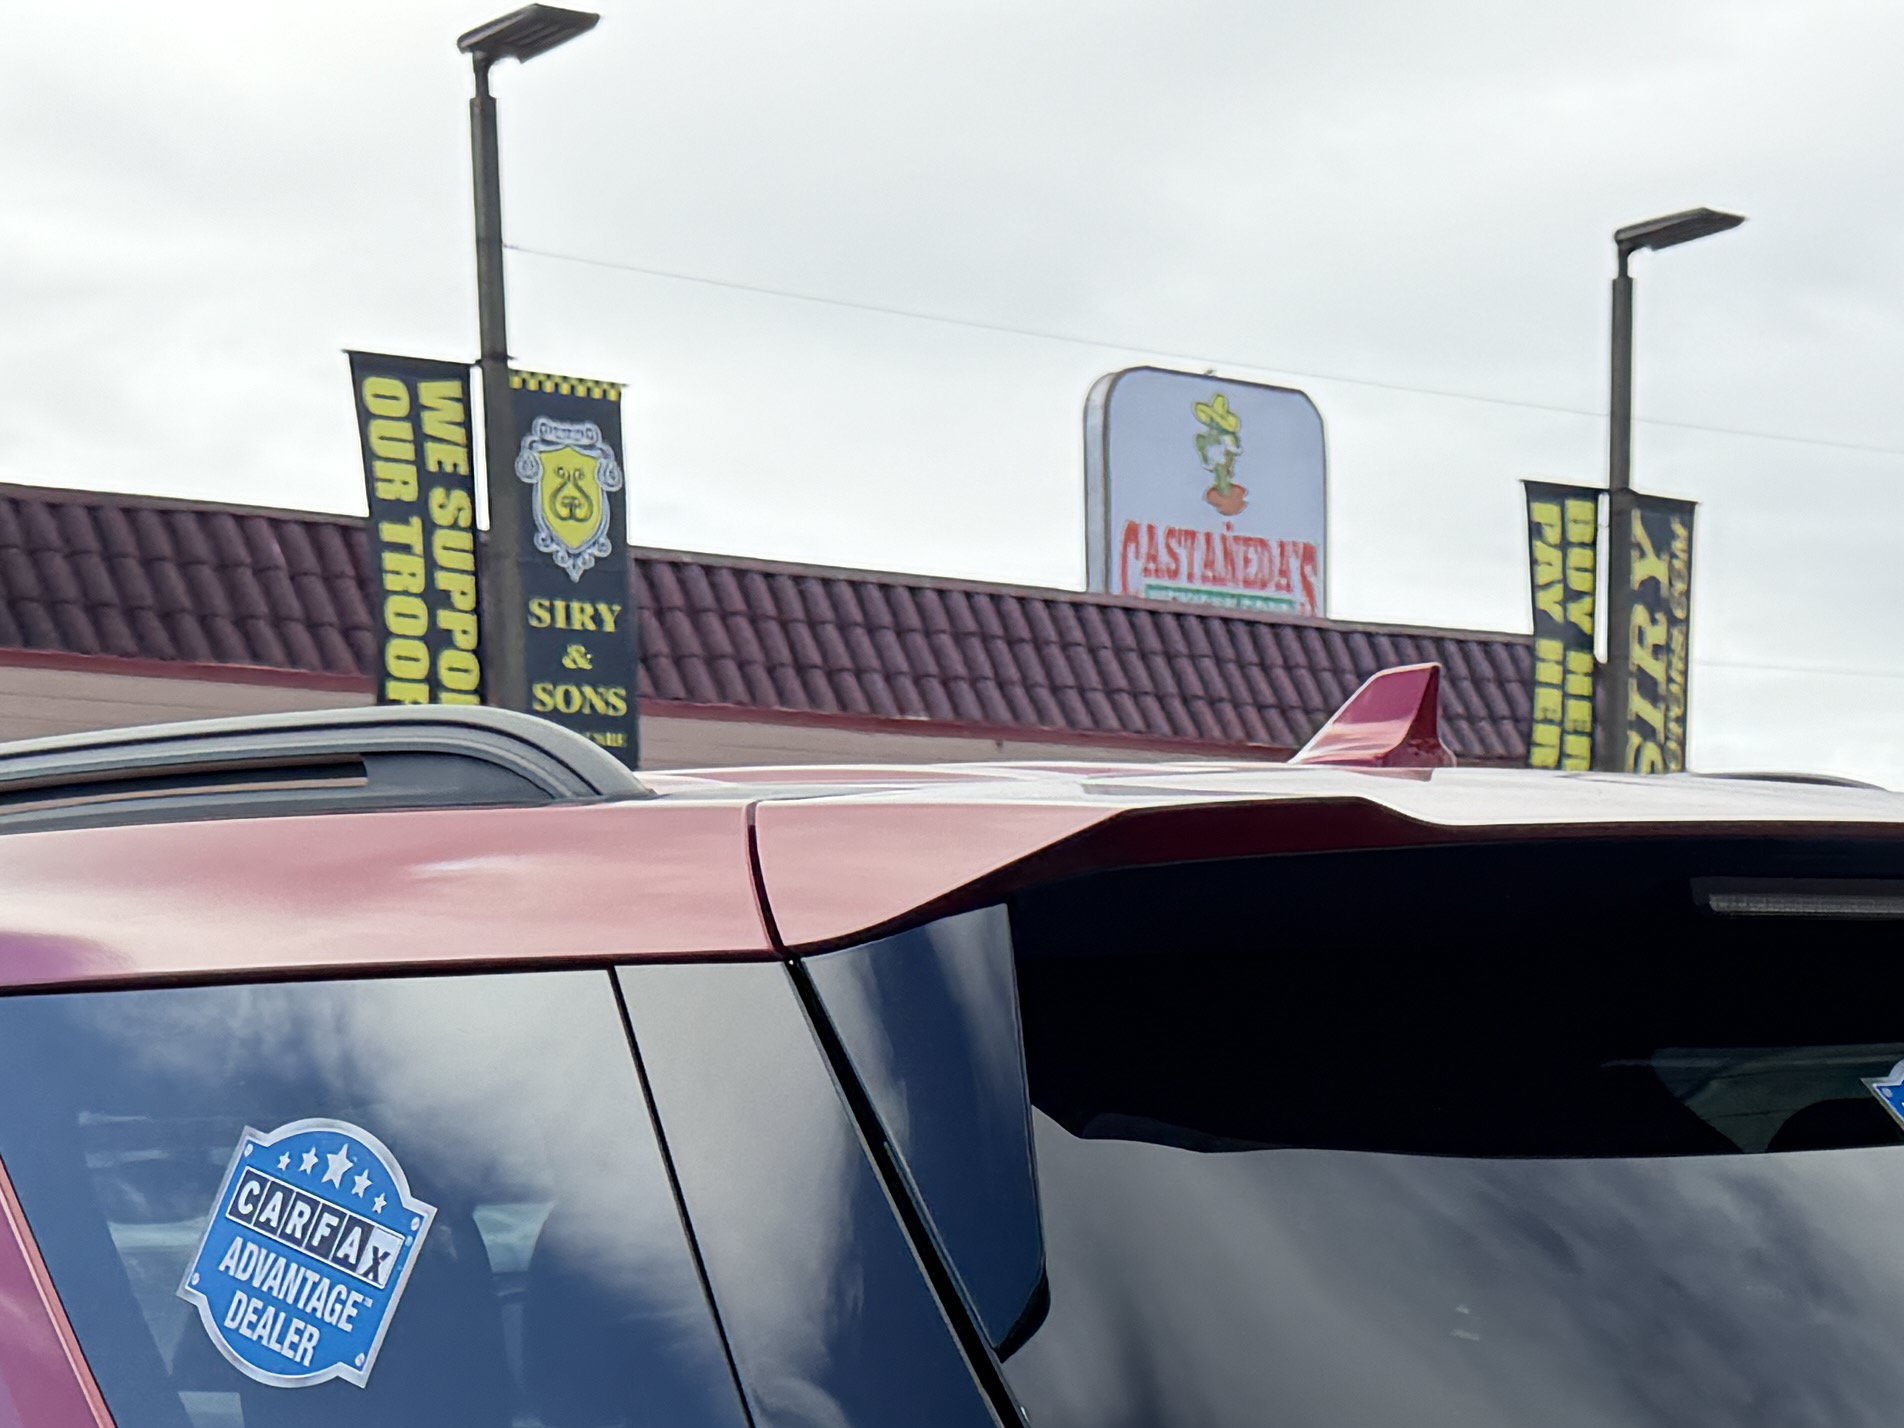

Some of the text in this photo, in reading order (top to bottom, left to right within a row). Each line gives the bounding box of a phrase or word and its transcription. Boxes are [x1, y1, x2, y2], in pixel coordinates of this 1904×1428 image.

[362, 376, 431, 705] OUR TROOP
[417, 379, 481, 705] WE SUPPO
[528, 597, 623, 633] SIRY
[561, 643, 594, 671] &
[1529, 502, 1564, 769] PAY HER
[1563, 498, 1595, 772] BUY HER
[532, 682, 629, 718] SONS
[236, 1178, 393, 1284] CARFAX
[218, 1235, 364, 1334] ADVANTAGE
[223, 1290, 321, 1368] DEALER
